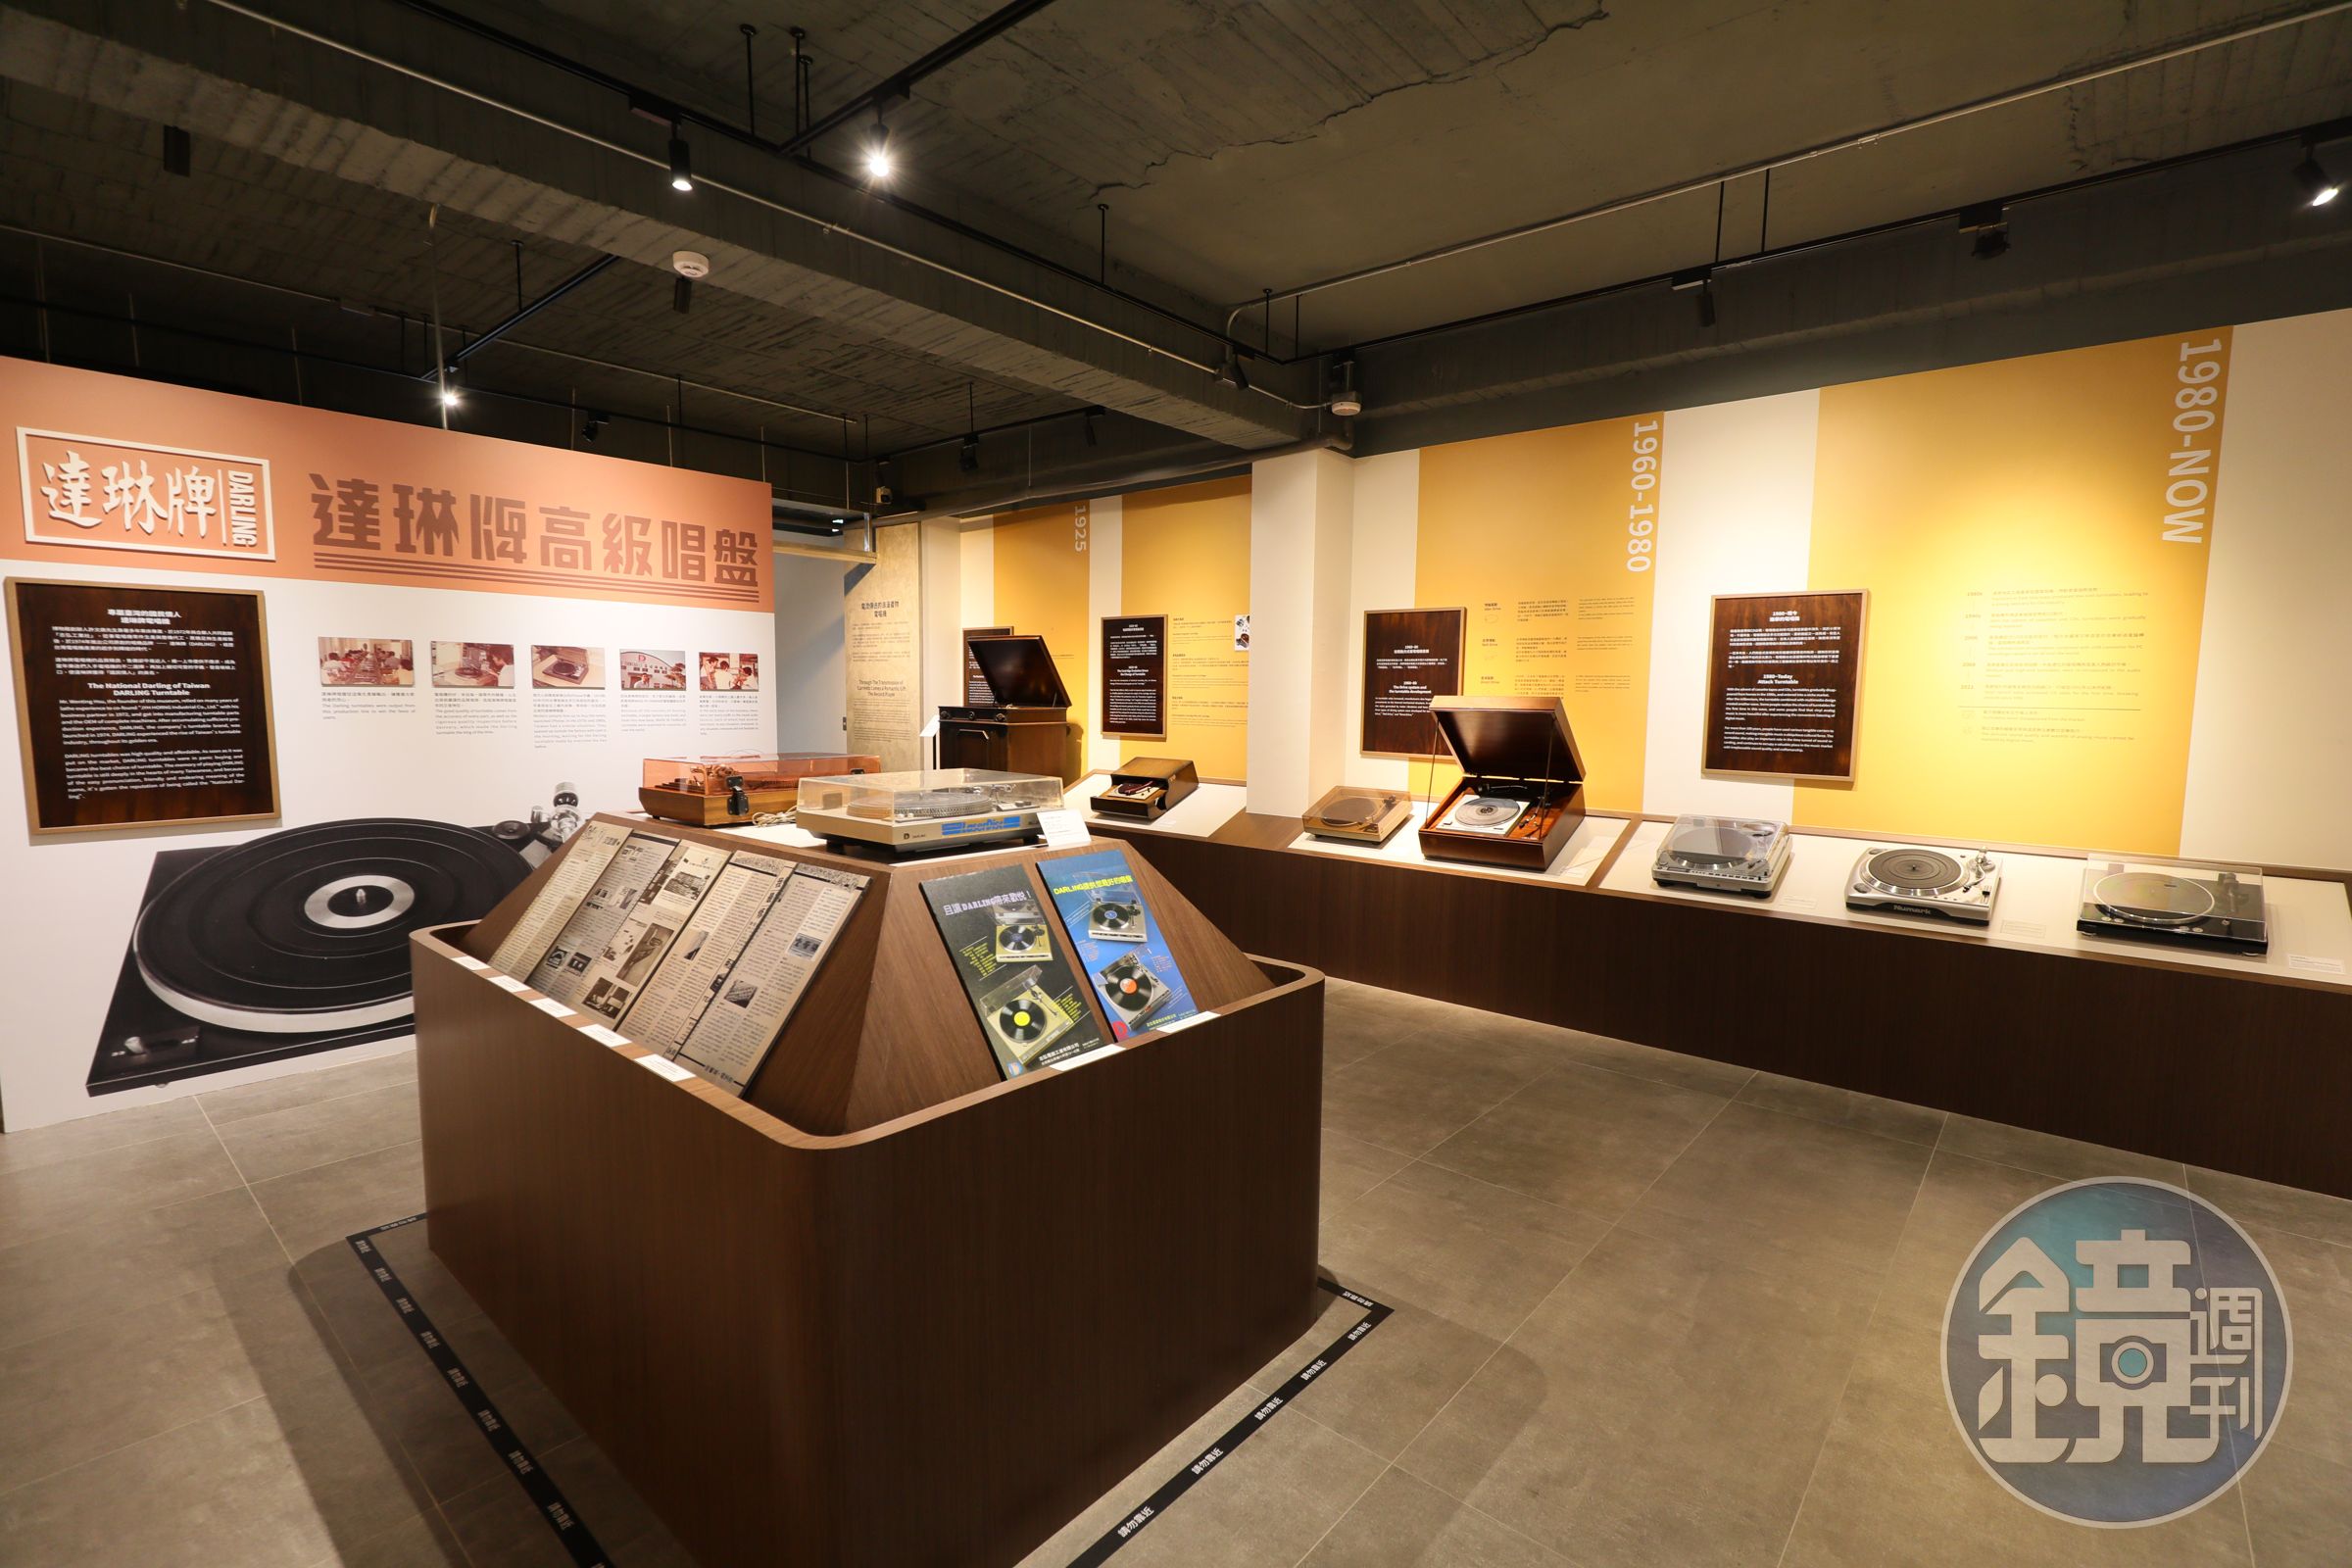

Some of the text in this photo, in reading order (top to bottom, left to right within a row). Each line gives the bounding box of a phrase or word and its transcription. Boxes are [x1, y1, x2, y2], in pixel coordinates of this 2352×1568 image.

[2162, 337, 2223, 544] 1980-NOW
[41, 450, 218, 538] 達琳牌
[225, 470, 257, 547] DARLING
[311, 473, 760, 588] 達琳牌高級唱盤
[1074, 505, 1088, 553] 1925
[1627, 419, 1659, 573] 1960-1980
[1892, 904, 1932, 916] Numark
[1192, 1447, 1223, 1474] 請勿靠近
[1117, 1506, 1154, 1538] 請勿靠近
